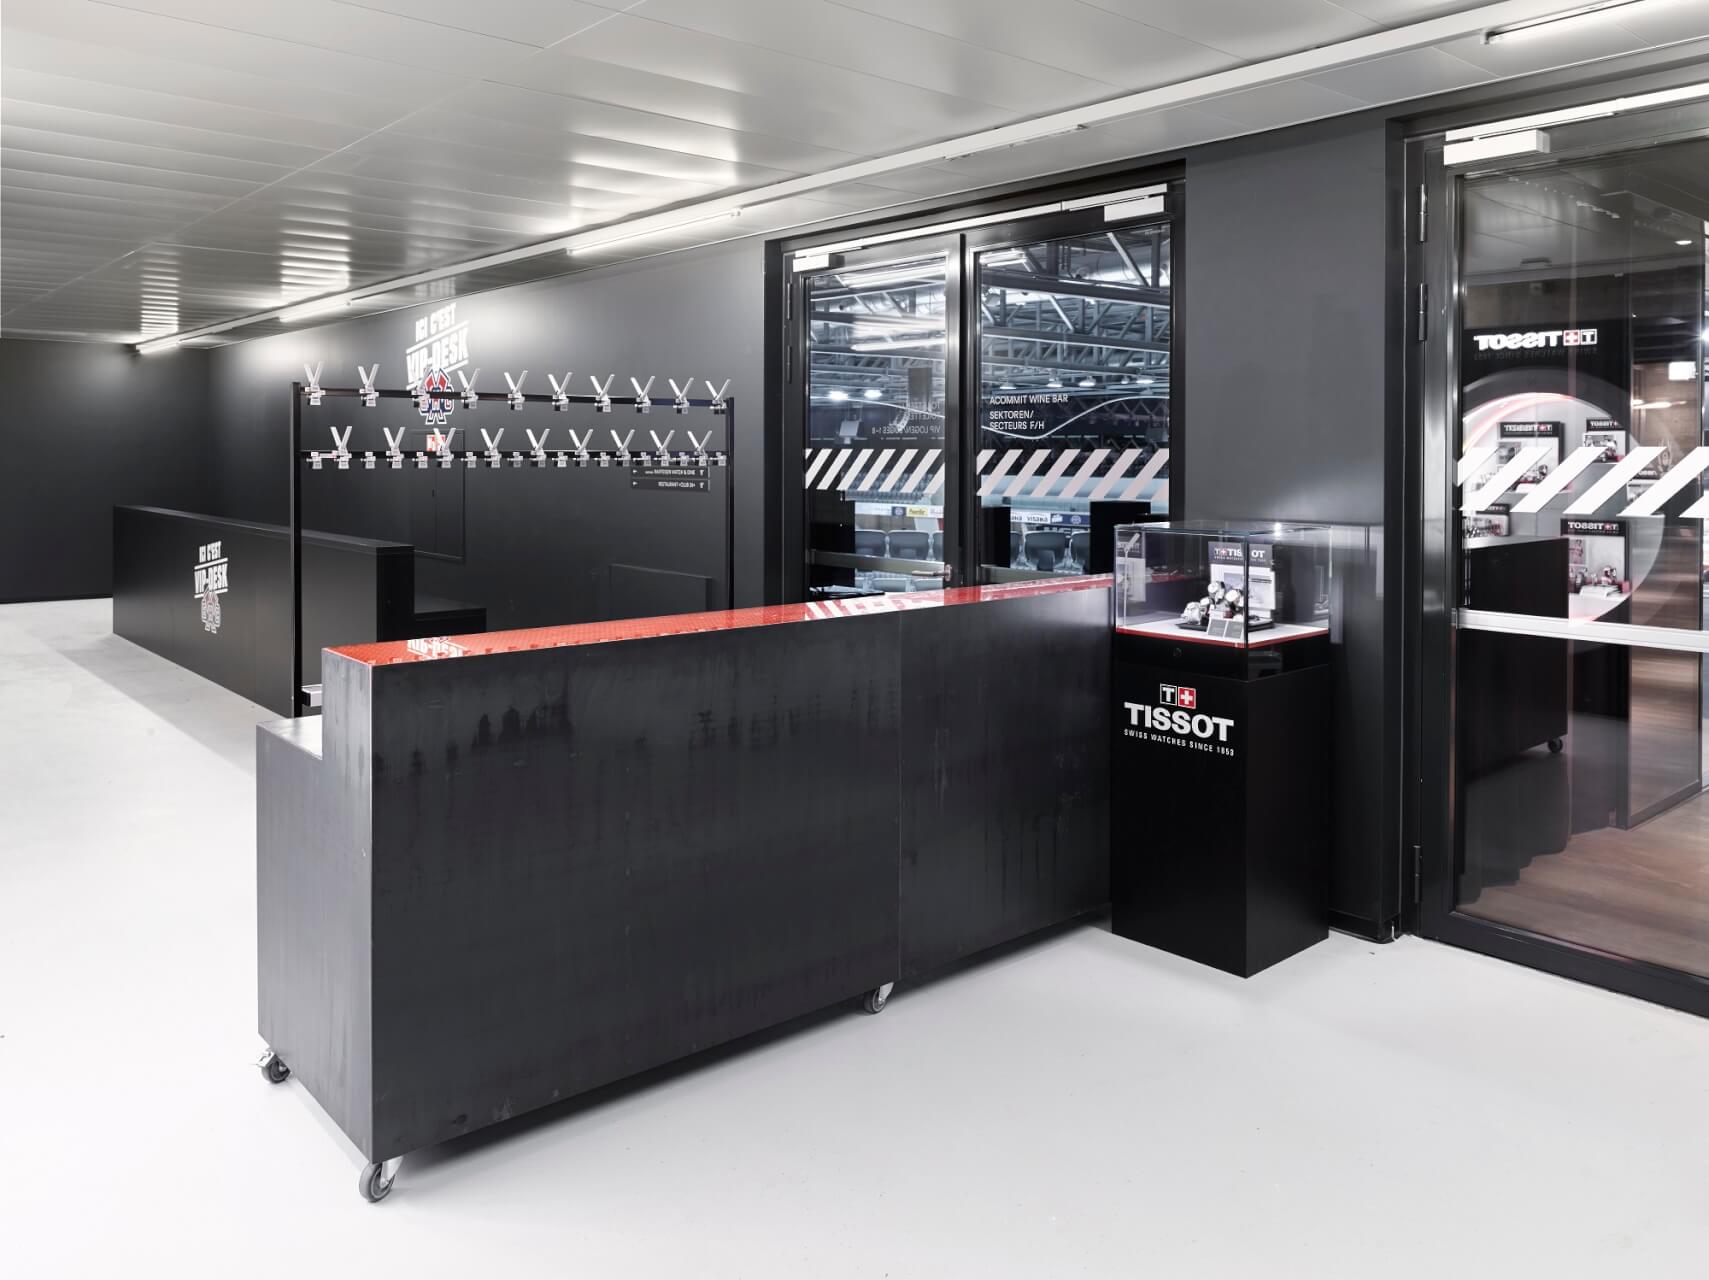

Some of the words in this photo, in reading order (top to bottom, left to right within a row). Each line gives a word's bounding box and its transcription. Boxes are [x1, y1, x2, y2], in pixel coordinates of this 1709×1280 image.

[989, 395, 1028, 405] ACOMMIT
[1029, 394, 1050, 404] WINE
[1052, 393, 1069, 403] BAR
[989, 410, 1034, 420] SEKTOREN/
[989, 421, 1028, 430] SECTEURS
[1030, 421, 1045, 430] F/H
[1227, 549, 1266, 558] TISOT
[194, 563, 228, 594] VIP-DESK
[1123, 702, 1235, 742] TISSOT
[1124, 728, 1148, 740] SWISS
[1151, 733, 1186, 747] WATCHES
[1189, 740, 1213, 752] SINCE
[1217, 746, 1235, 757] 1853
